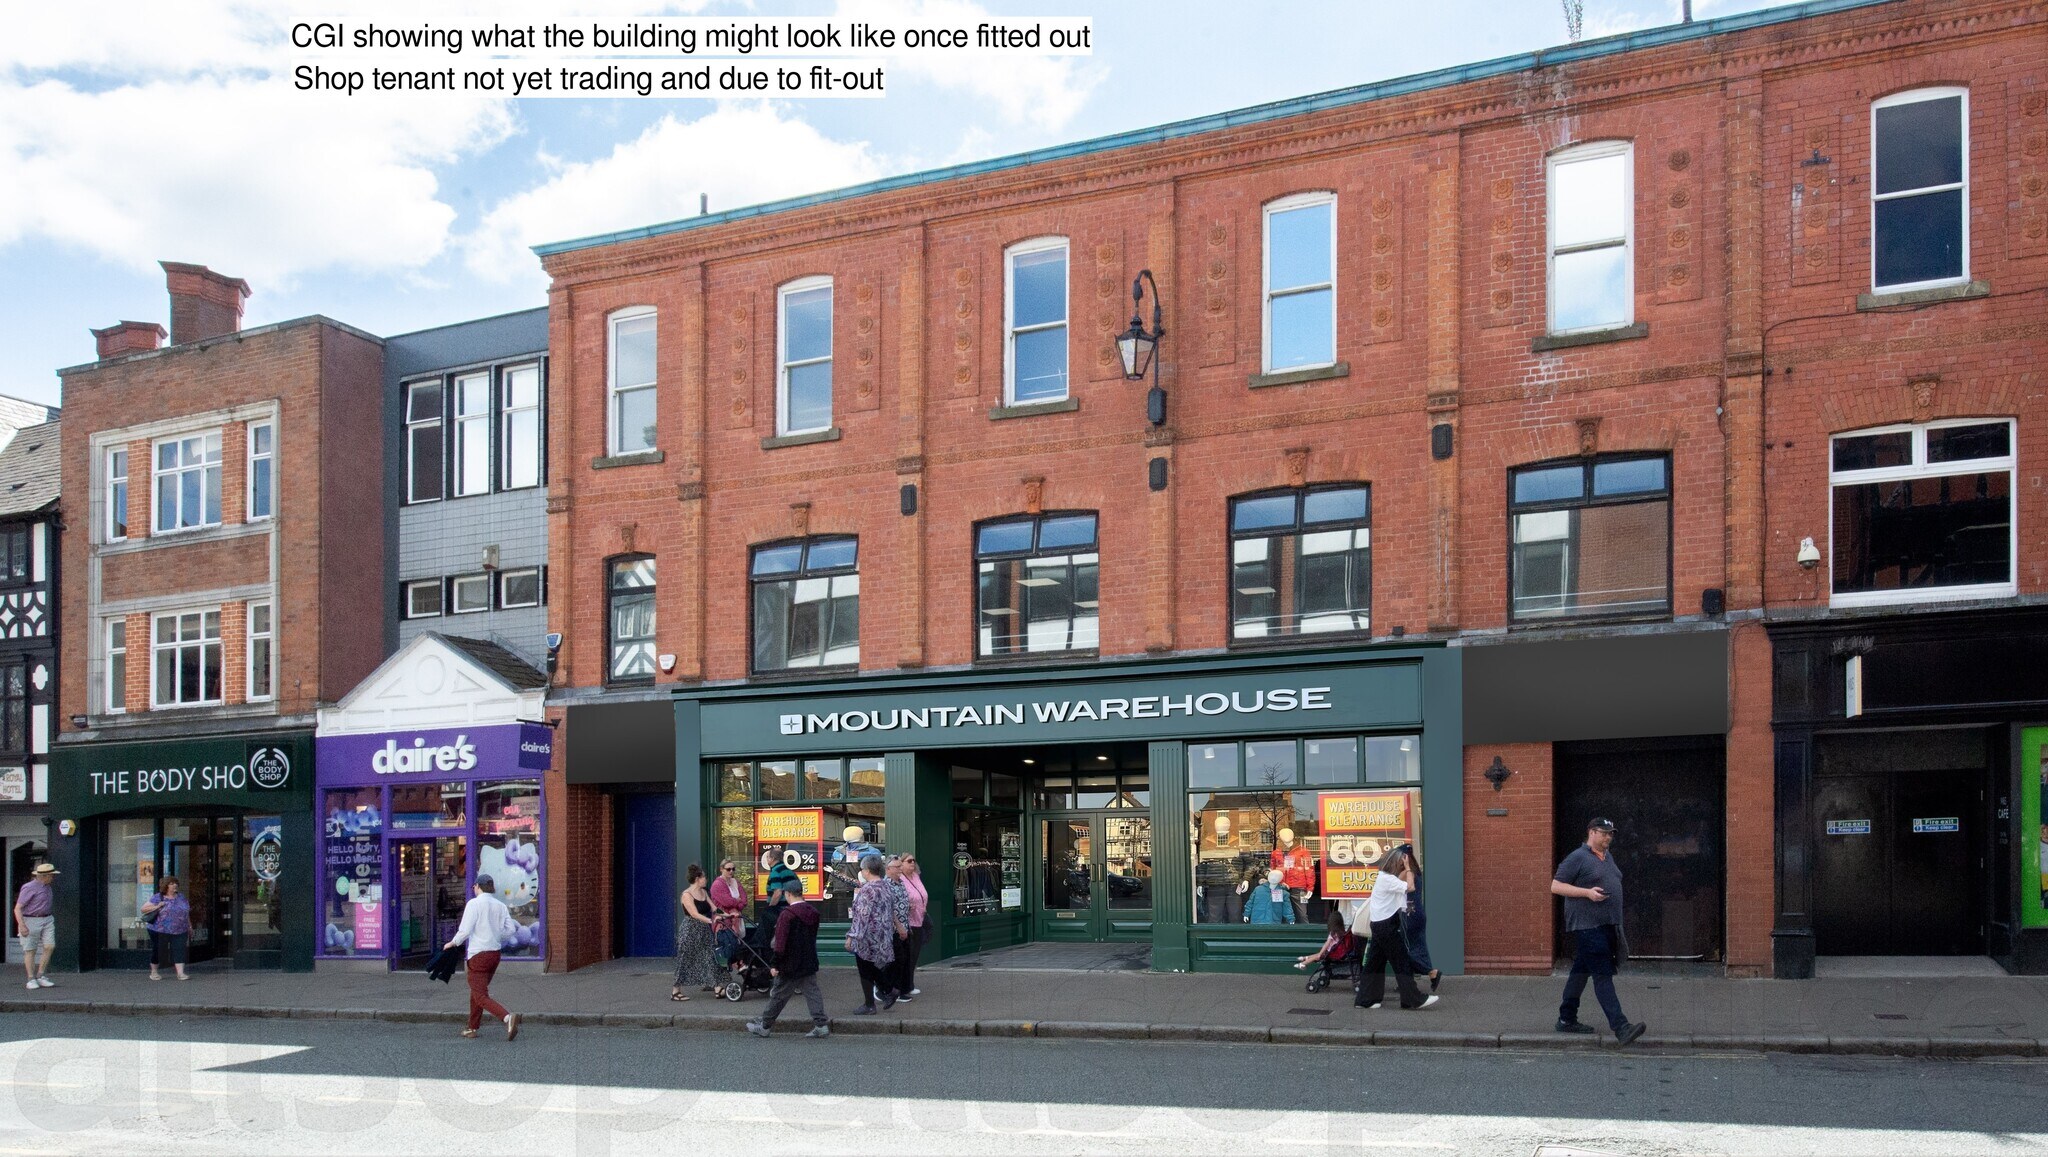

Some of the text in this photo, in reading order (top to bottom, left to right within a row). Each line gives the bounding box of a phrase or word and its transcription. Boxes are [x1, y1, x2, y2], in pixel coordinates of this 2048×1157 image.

[808, 686, 1333, 733] MOUNTAIN WAREHOUSE
[521, 741, 550, 754] claire's
[372, 735, 478, 774] claire's
[262, 759, 278, 767] THE
[258, 766, 282, 774] BODY
[90, 764, 246, 795] THE BODY SHO
[259, 773, 282, 781] SHOP
[1328, 800, 1401, 813] WAREHOUSE
[762, 815, 816, 827] WAREHOUSE
[1329, 813, 1401, 827] CLEARANCE
[762, 827, 816, 838] CLEARANCE
[262, 844, 276, 853] THE
[328, 845, 354, 854] HELLO
[1329, 840, 1391, 865] 60
[258, 852, 281, 862] BODY
[326, 856, 352, 864] HELLO
[259, 861, 280, 871] SHOP
[1342, 871, 1379, 883] HUG
[1343, 883, 1374, 891] SAVIN
